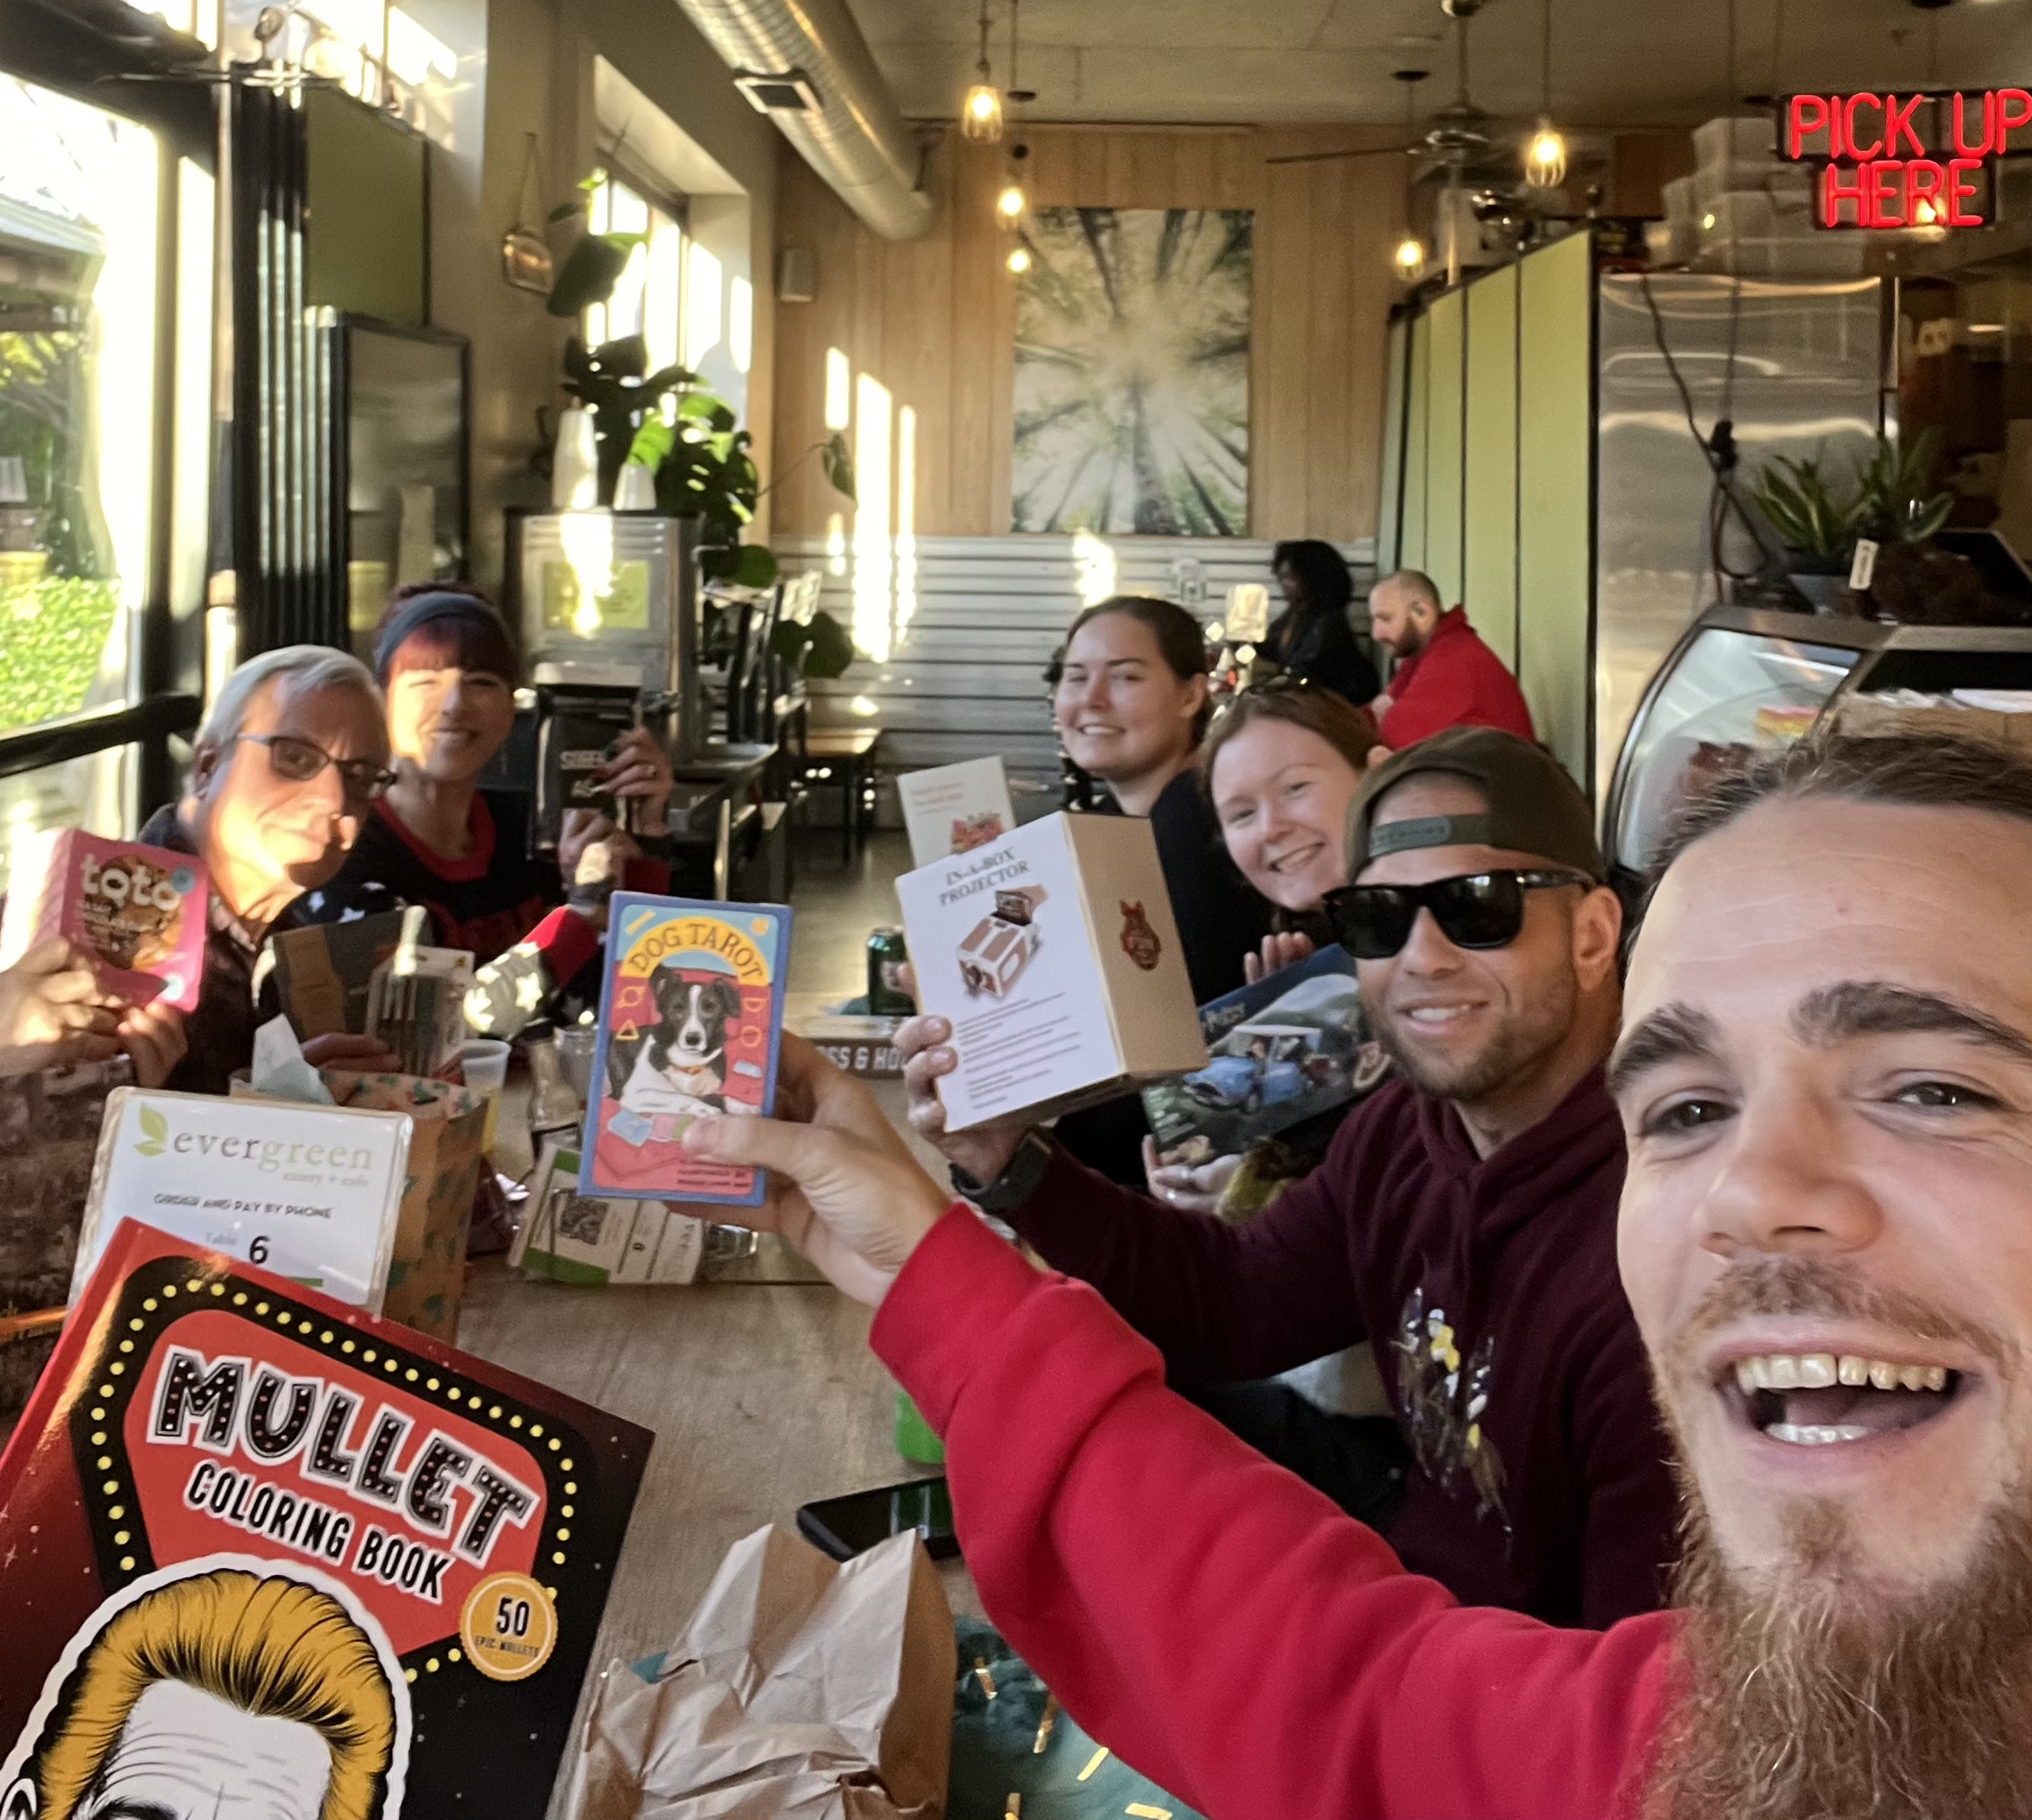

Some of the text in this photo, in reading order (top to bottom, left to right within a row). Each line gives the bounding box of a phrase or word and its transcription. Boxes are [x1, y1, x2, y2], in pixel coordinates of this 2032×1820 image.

[1790, 88, 2032, 161] PICK UP
[1825, 158, 1984, 228] HERE
[939, 859, 1030, 906] PROJECTOR
[628, 922, 763, 978] DOG TAROT
[173, 1130, 372, 1173] evergreen
[233, 1200, 261, 1213] PAY
[264, 1203, 283, 1215] BY
[285, 1205, 333, 1220] PHONE
[248, 1235, 272, 1265] 6
[150, 1347, 538, 1566] MULLET
[186, 1460, 452, 1602] COLORING BOOK
[496, 1596, 530, 1637] 50
